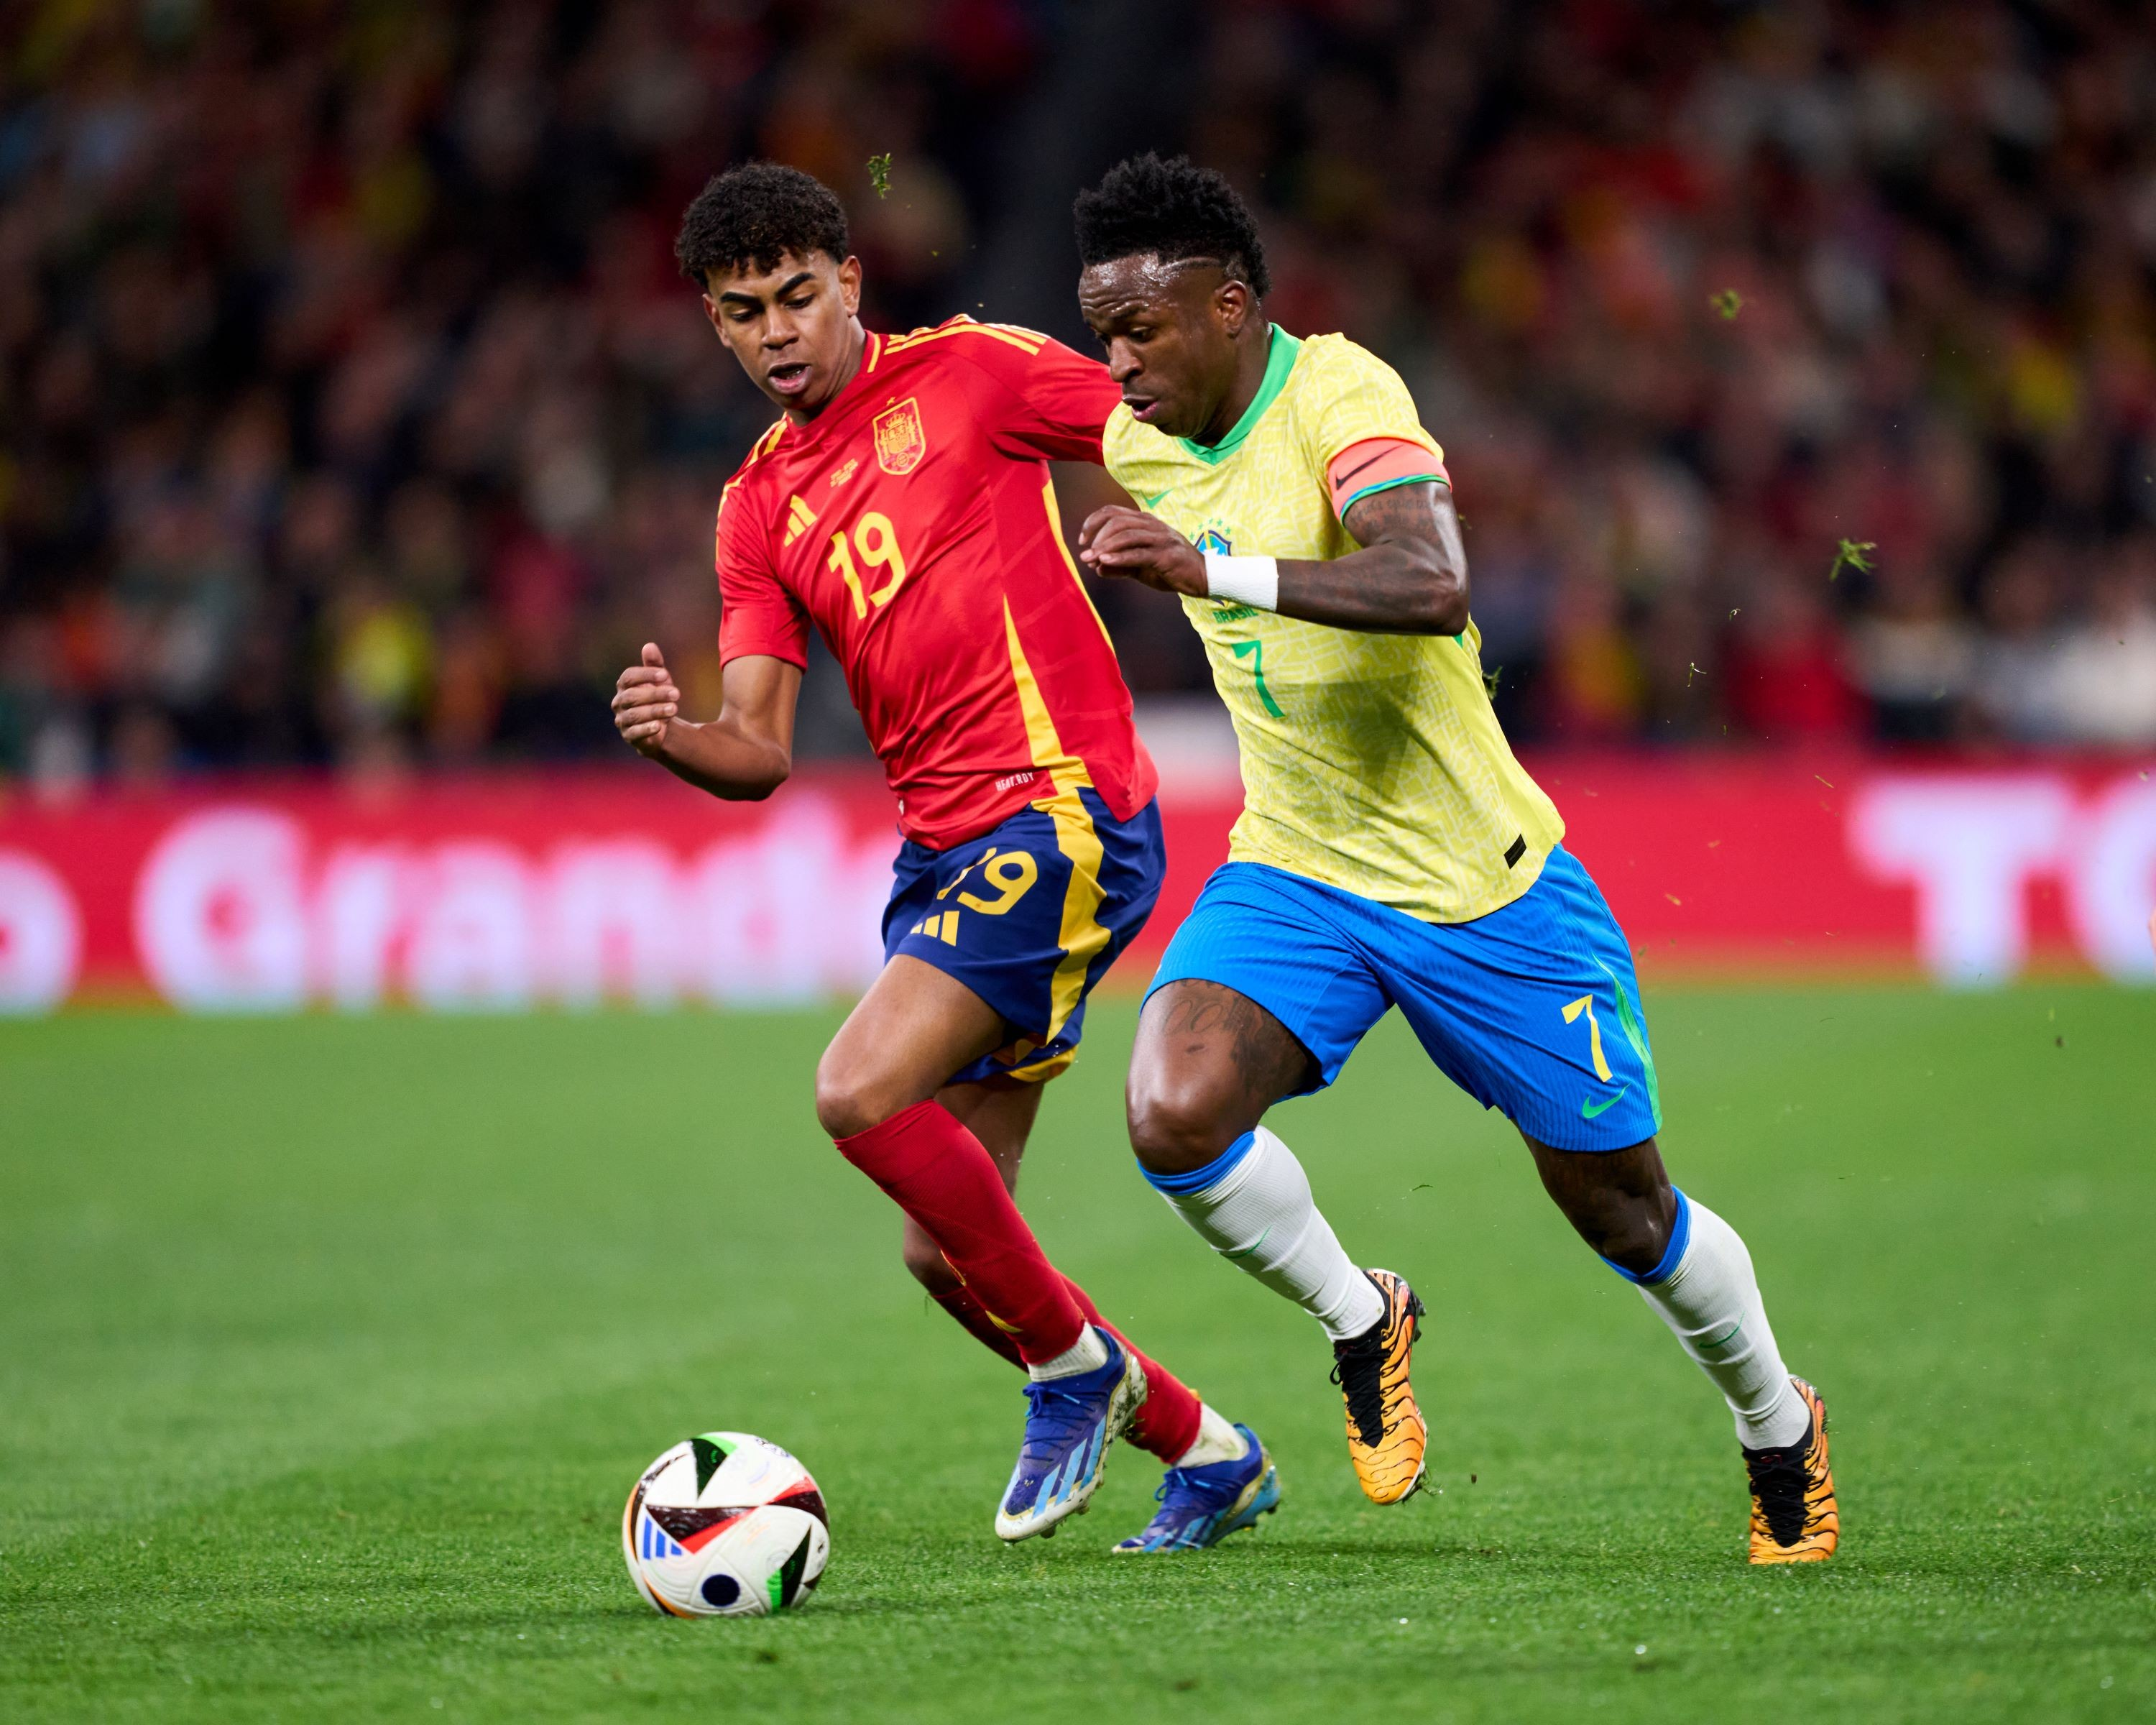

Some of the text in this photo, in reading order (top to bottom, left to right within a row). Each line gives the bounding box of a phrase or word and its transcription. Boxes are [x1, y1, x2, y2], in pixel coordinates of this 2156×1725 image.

[827, 511, 906, 620] 19
[1212, 607, 1258, 624] BRASIL
[1230, 640, 1286, 718] 7
[995, 772, 1034, 792] HEAT.RDY
[1562, 994, 1613, 1082] 7
